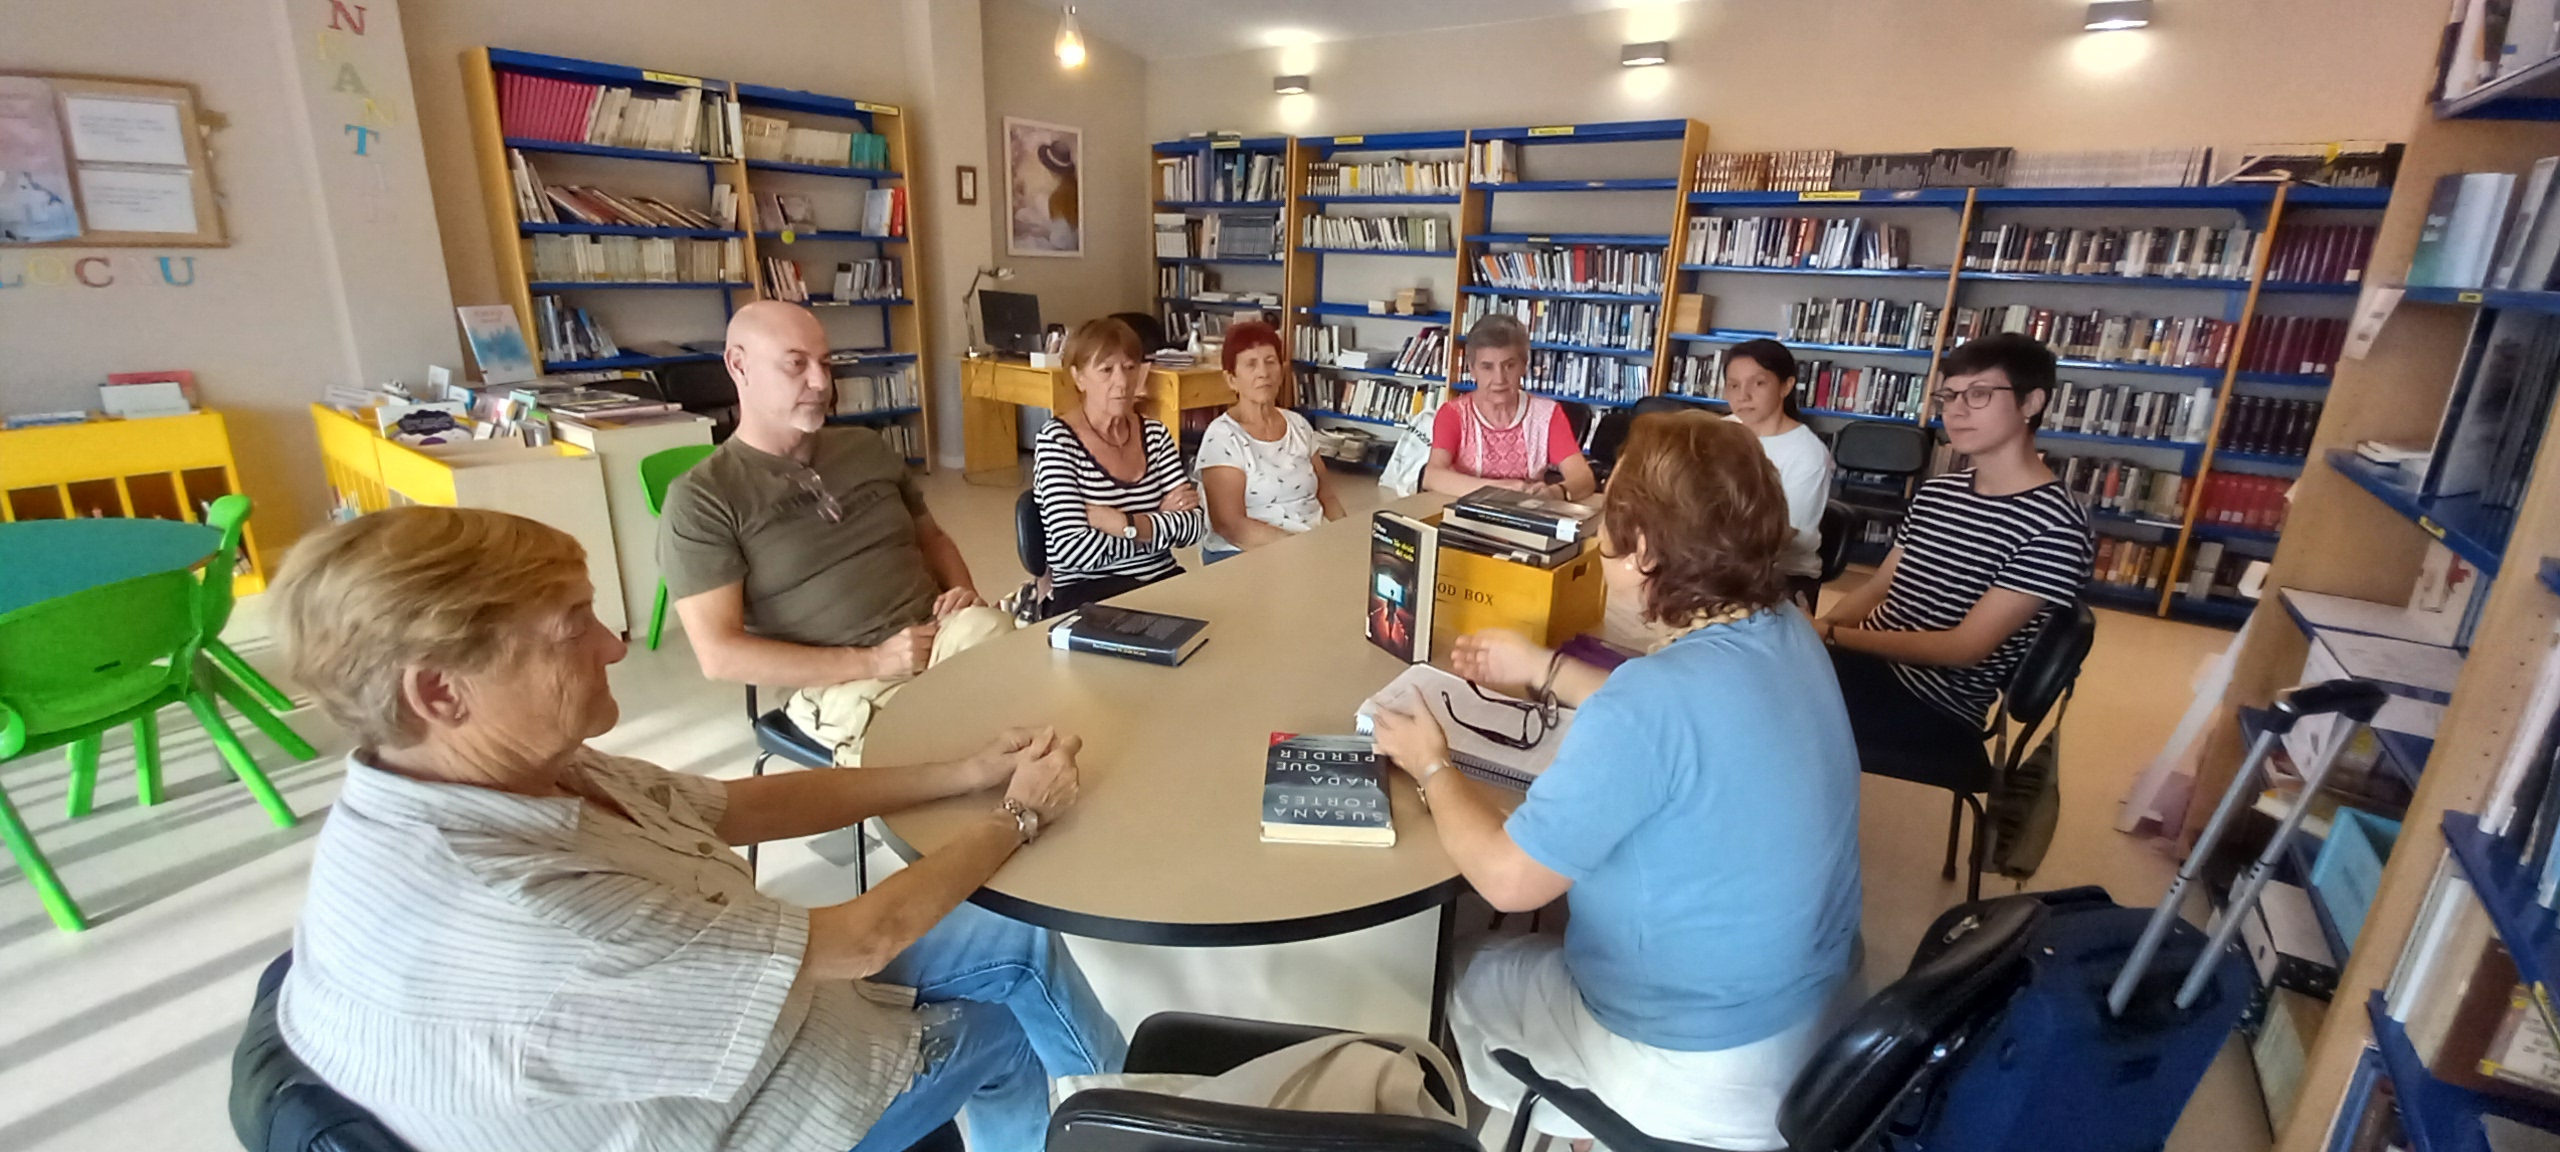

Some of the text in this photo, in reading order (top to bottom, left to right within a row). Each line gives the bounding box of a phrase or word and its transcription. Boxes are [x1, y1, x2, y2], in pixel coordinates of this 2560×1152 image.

[1464, 588, 1494, 606] BOX
[1280, 749, 1375, 762] PERDER
[1276, 761, 1320, 772] QUE
[1311, 776, 1377, 787] NADA
[1279, 795, 1376, 808] FORTES
[1274, 807, 1383, 821] SUSANA
